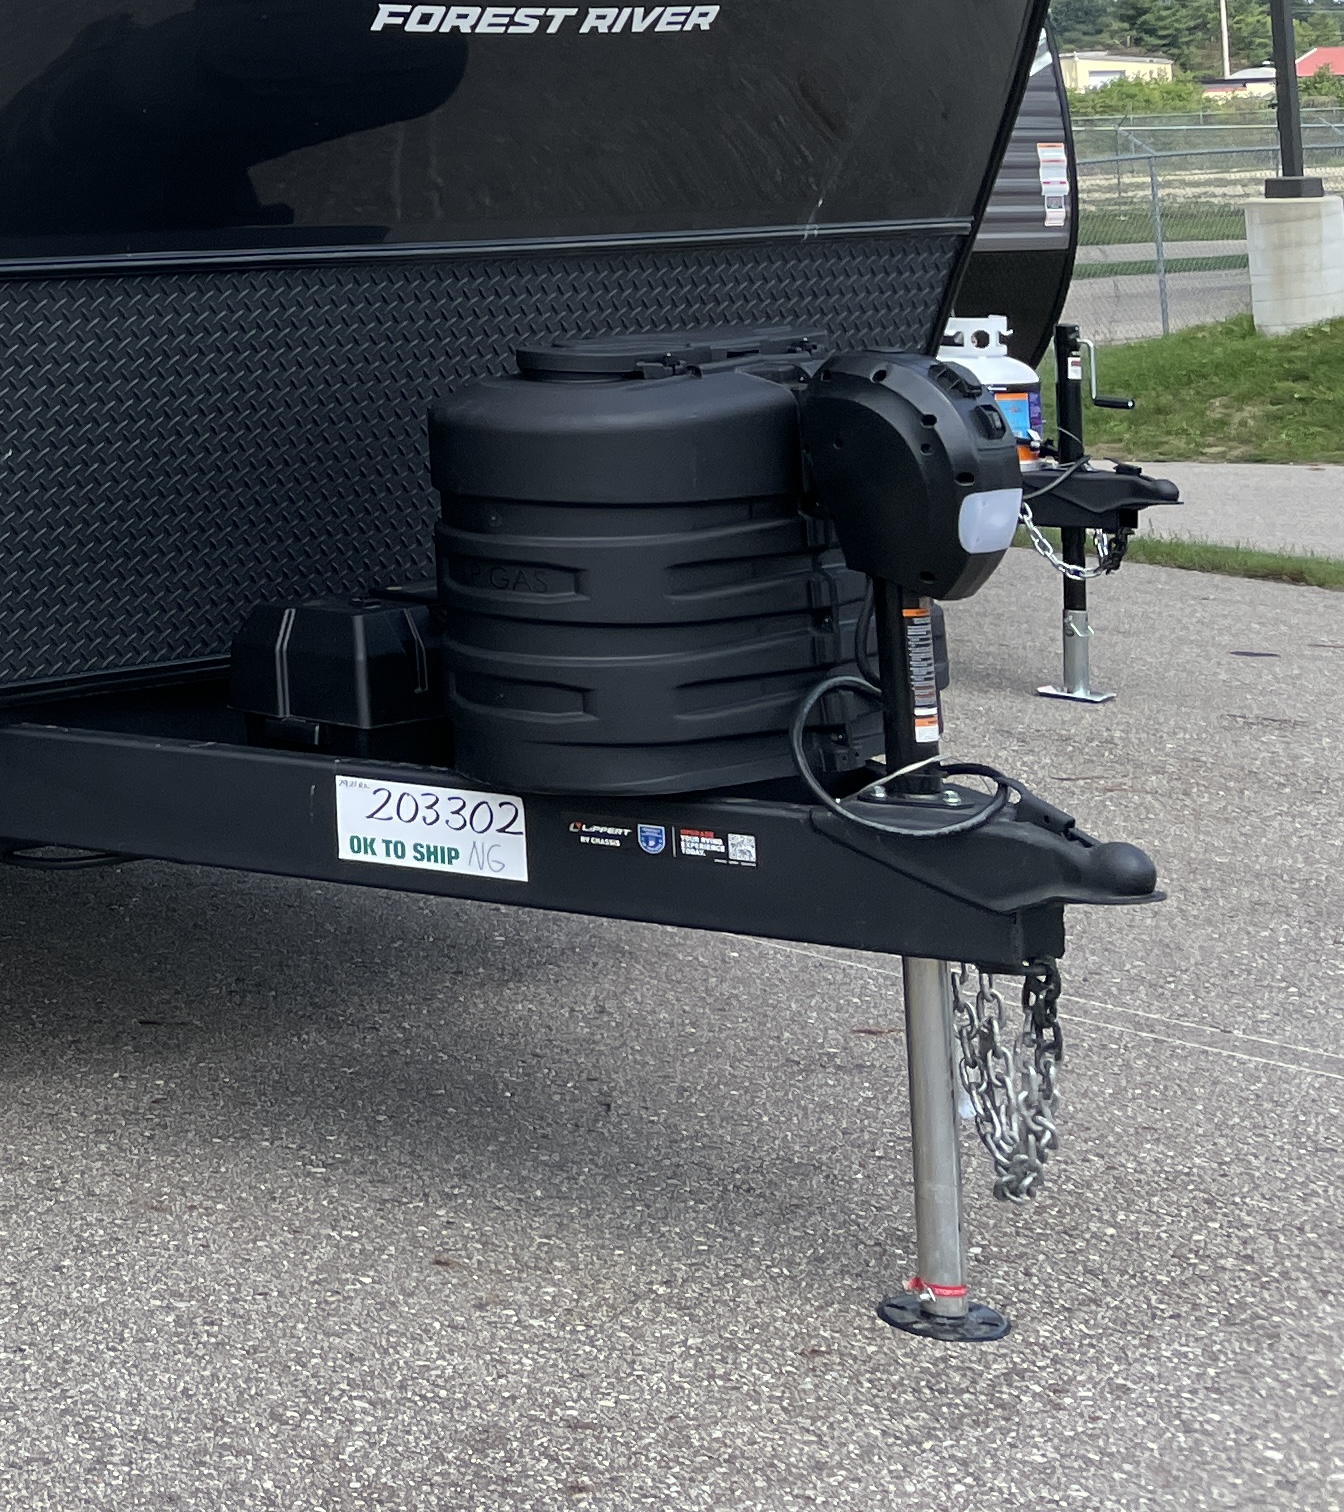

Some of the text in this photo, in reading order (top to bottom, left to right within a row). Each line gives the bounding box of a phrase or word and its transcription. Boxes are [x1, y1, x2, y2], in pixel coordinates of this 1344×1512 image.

[370, 3, 721, 35] FOREST RIVER
[365, 787, 524, 836] 203302
[349, 834, 461, 866] OK TO SHIP
